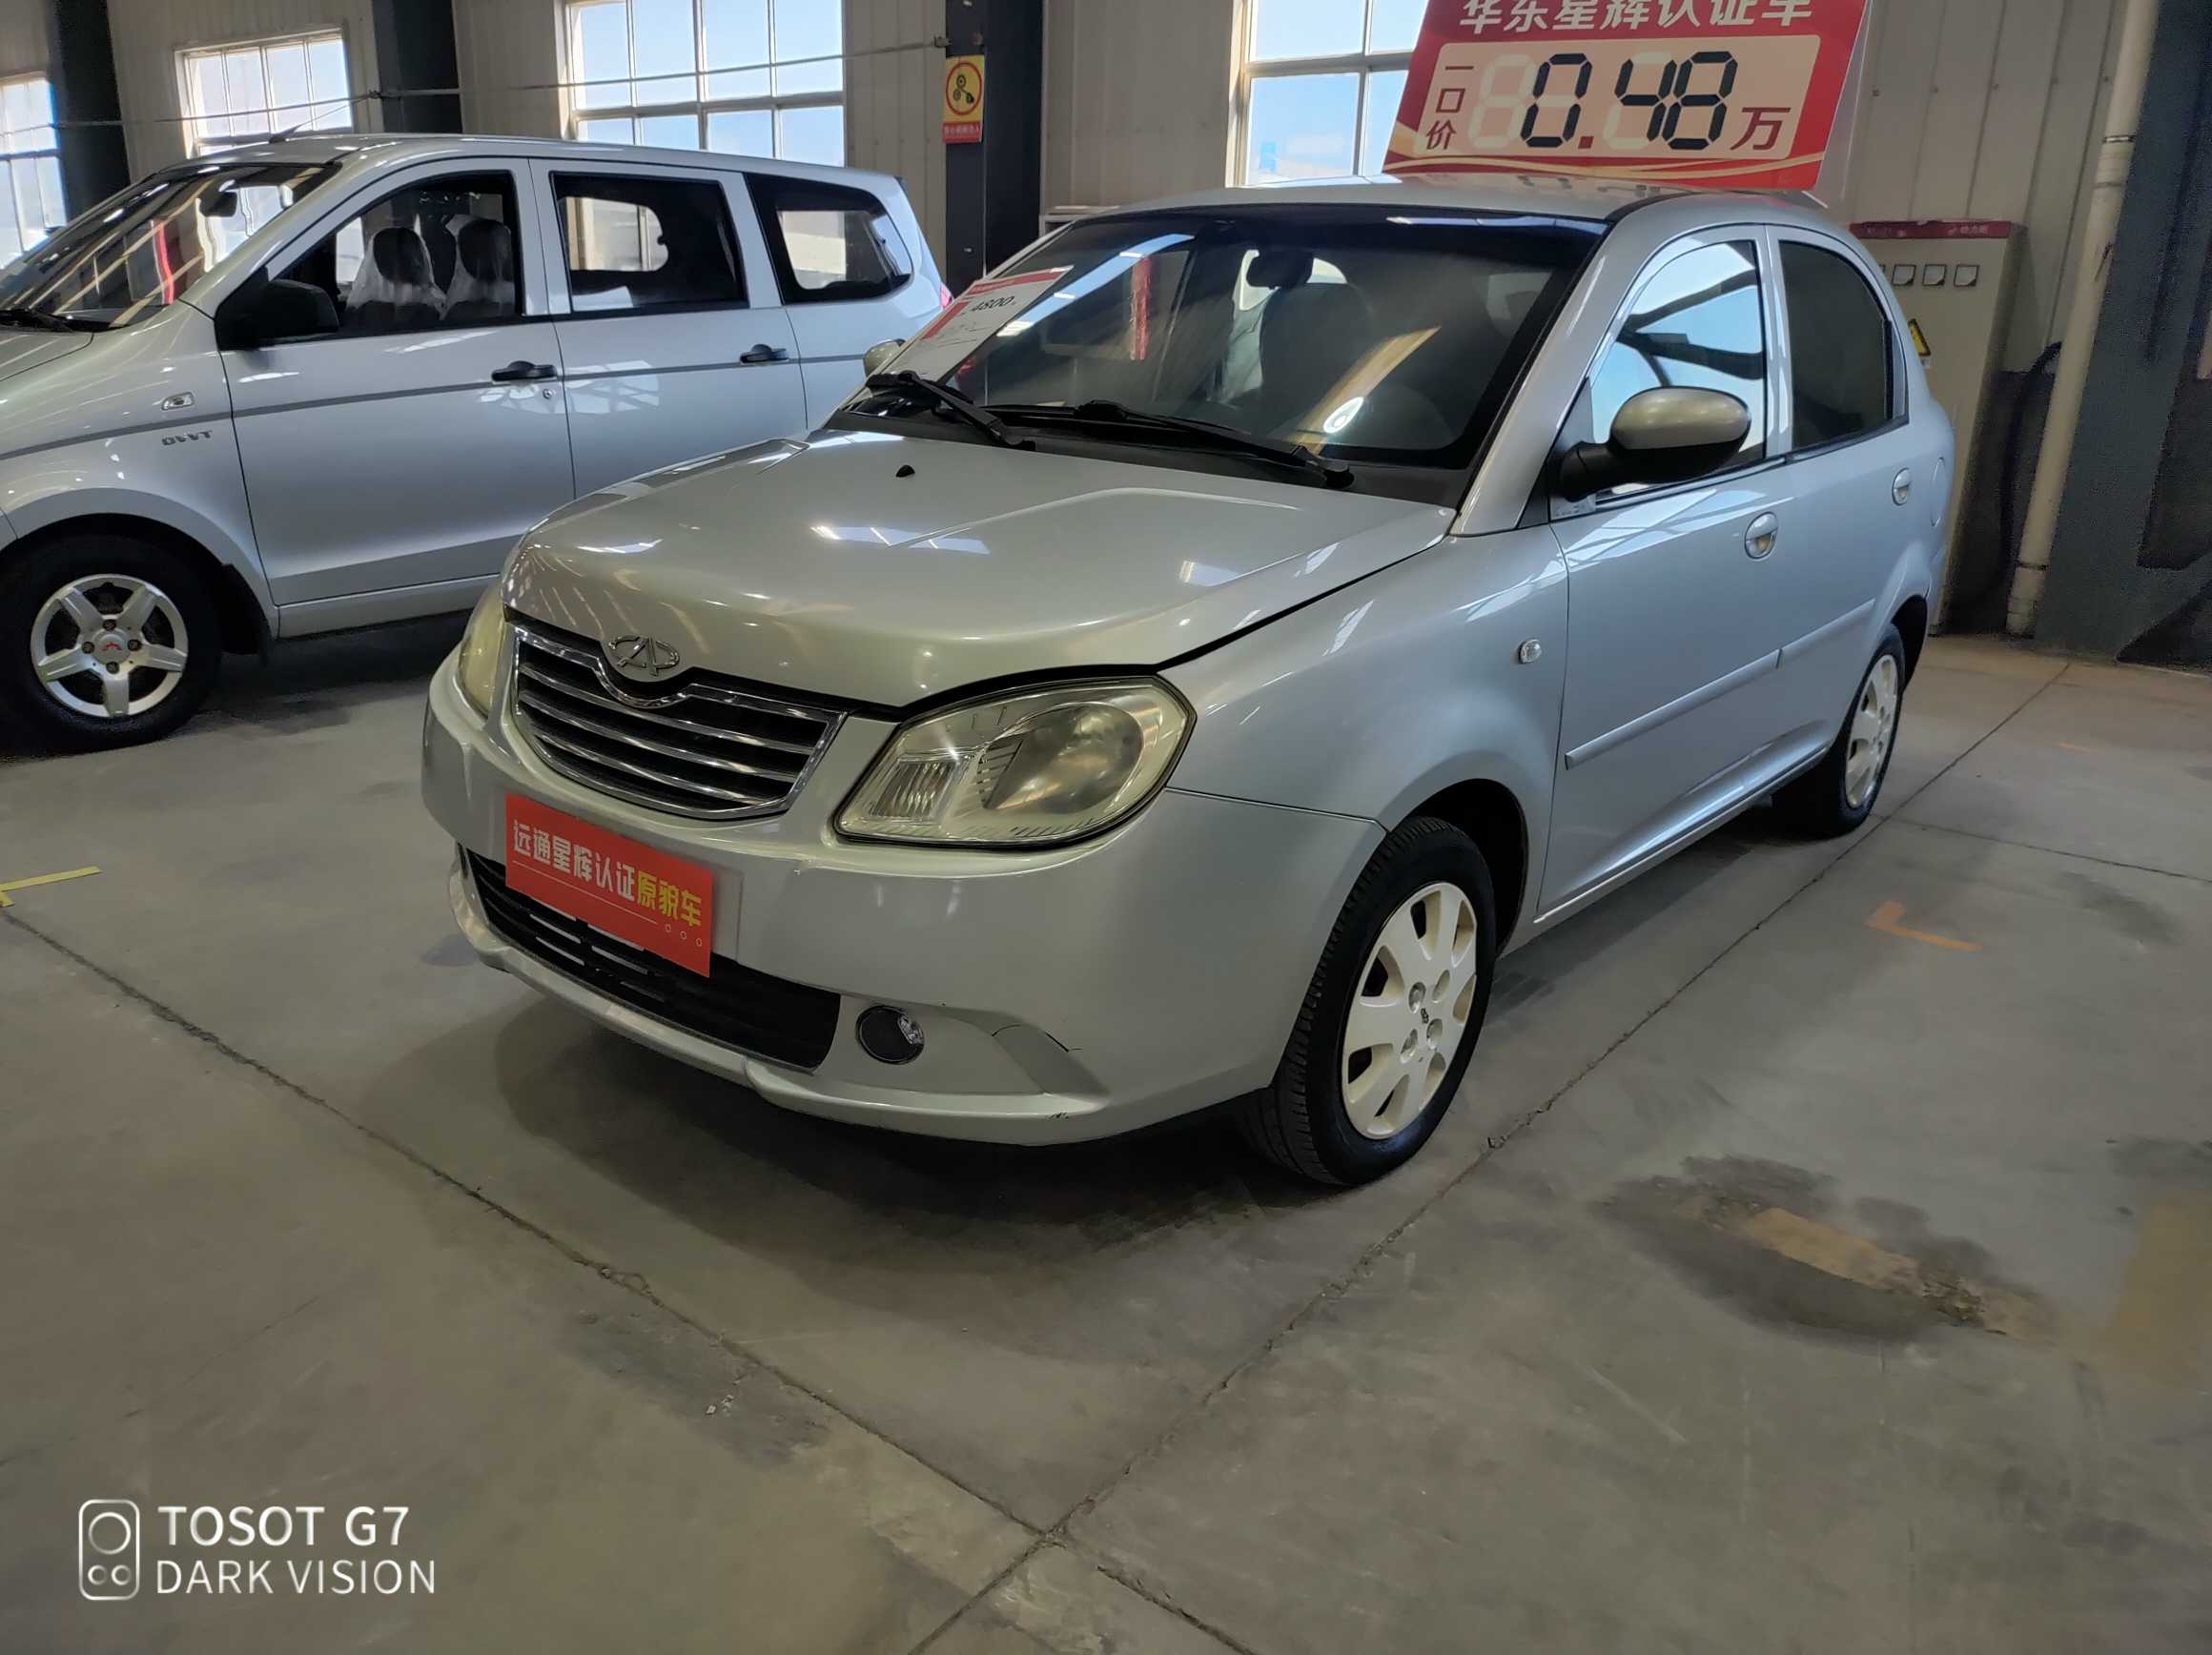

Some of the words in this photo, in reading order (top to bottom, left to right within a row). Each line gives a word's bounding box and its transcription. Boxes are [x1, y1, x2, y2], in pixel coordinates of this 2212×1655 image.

[1425, 65, 1474, 151] 一口价
[1520, 51, 1738, 151] 0.48
